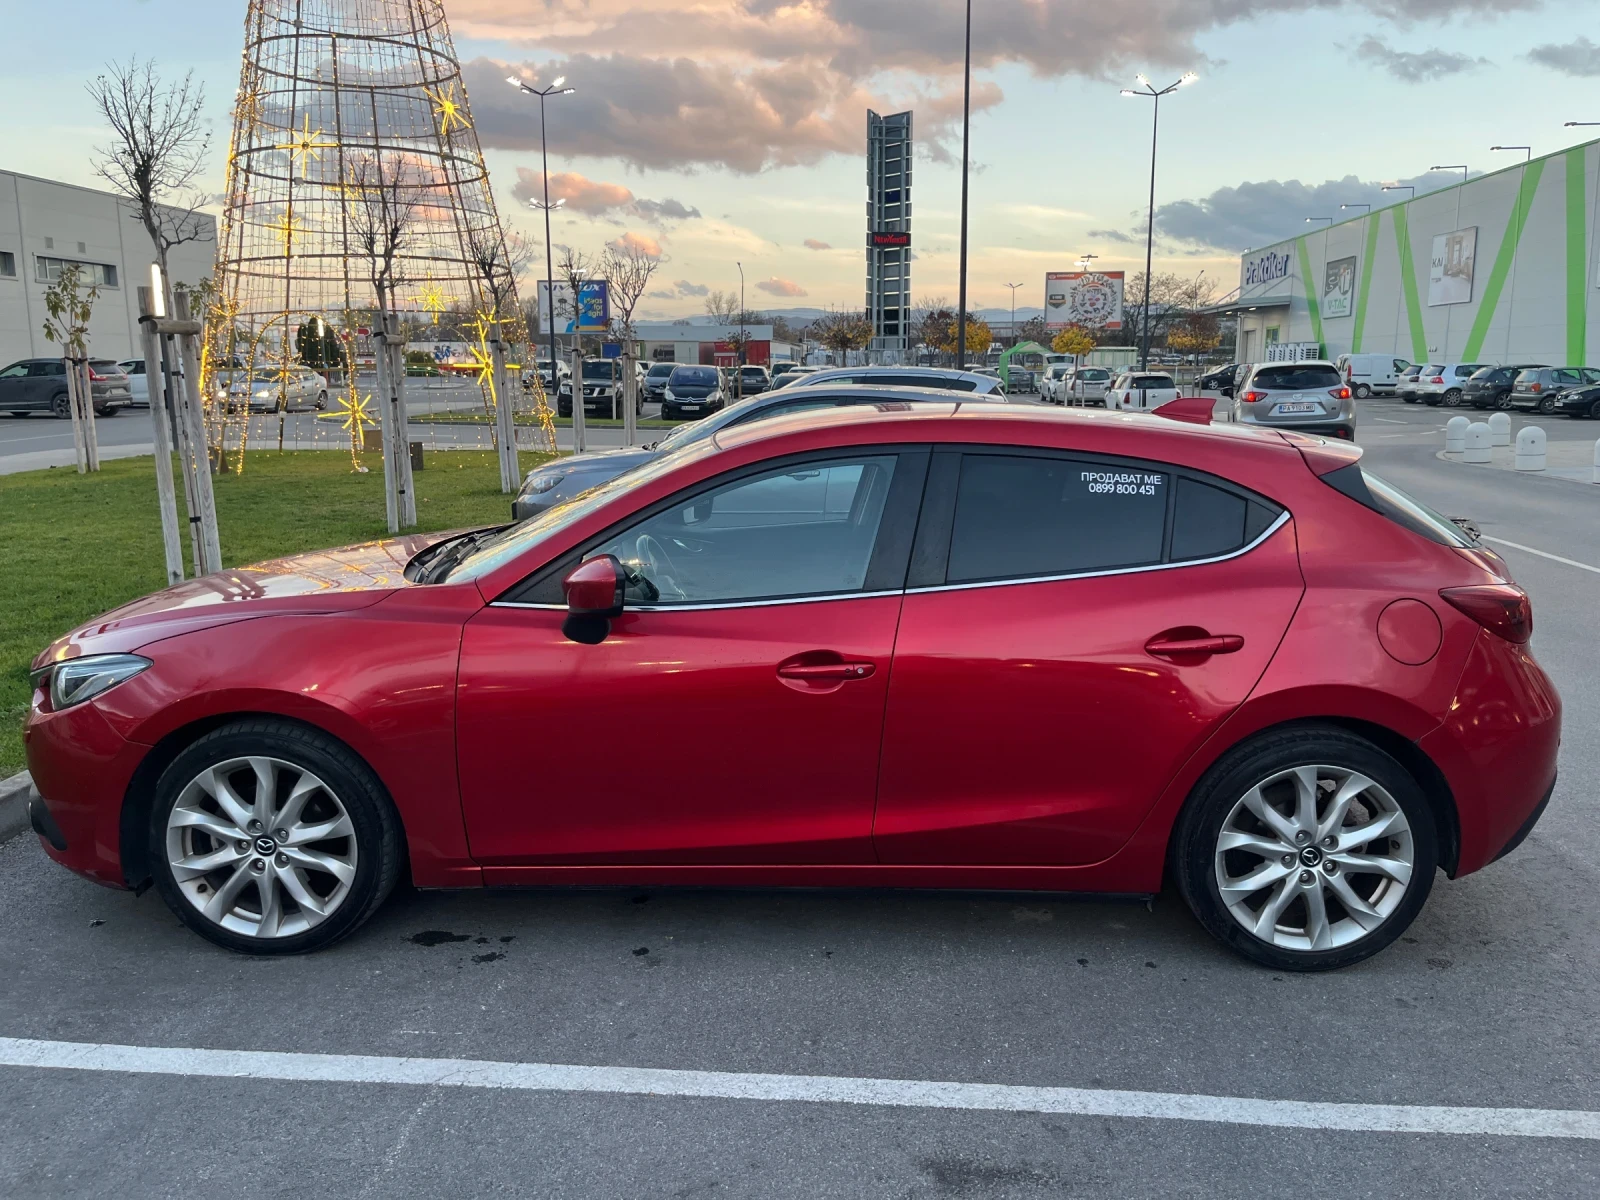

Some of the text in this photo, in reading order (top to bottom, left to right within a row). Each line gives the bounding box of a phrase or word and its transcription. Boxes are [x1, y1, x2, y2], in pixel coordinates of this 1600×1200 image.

[1246, 252, 1289, 285] Praktiker
[1081, 472, 1142, 483] ПРОДАВАТ
[1089, 483, 1155, 495] 0899 800 451
